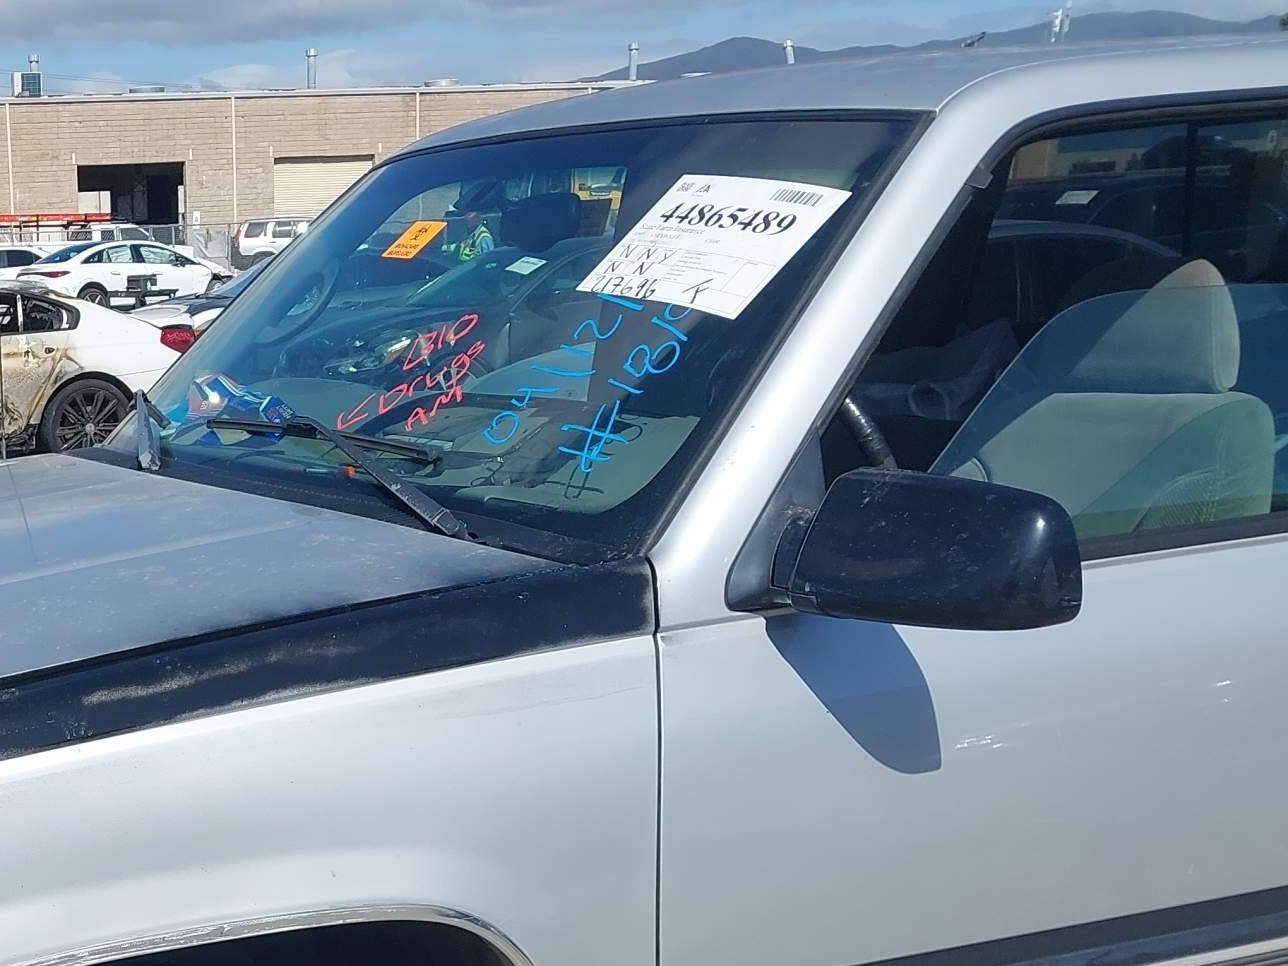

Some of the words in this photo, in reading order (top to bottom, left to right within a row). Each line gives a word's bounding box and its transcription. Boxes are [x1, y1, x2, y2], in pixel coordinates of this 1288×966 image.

[660, 202, 797, 236] 44865489
[620, 244, 638, 259] N
[637, 248, 657, 261] N
[604, 261, 621, 274] N
[633, 262, 655, 275] N
